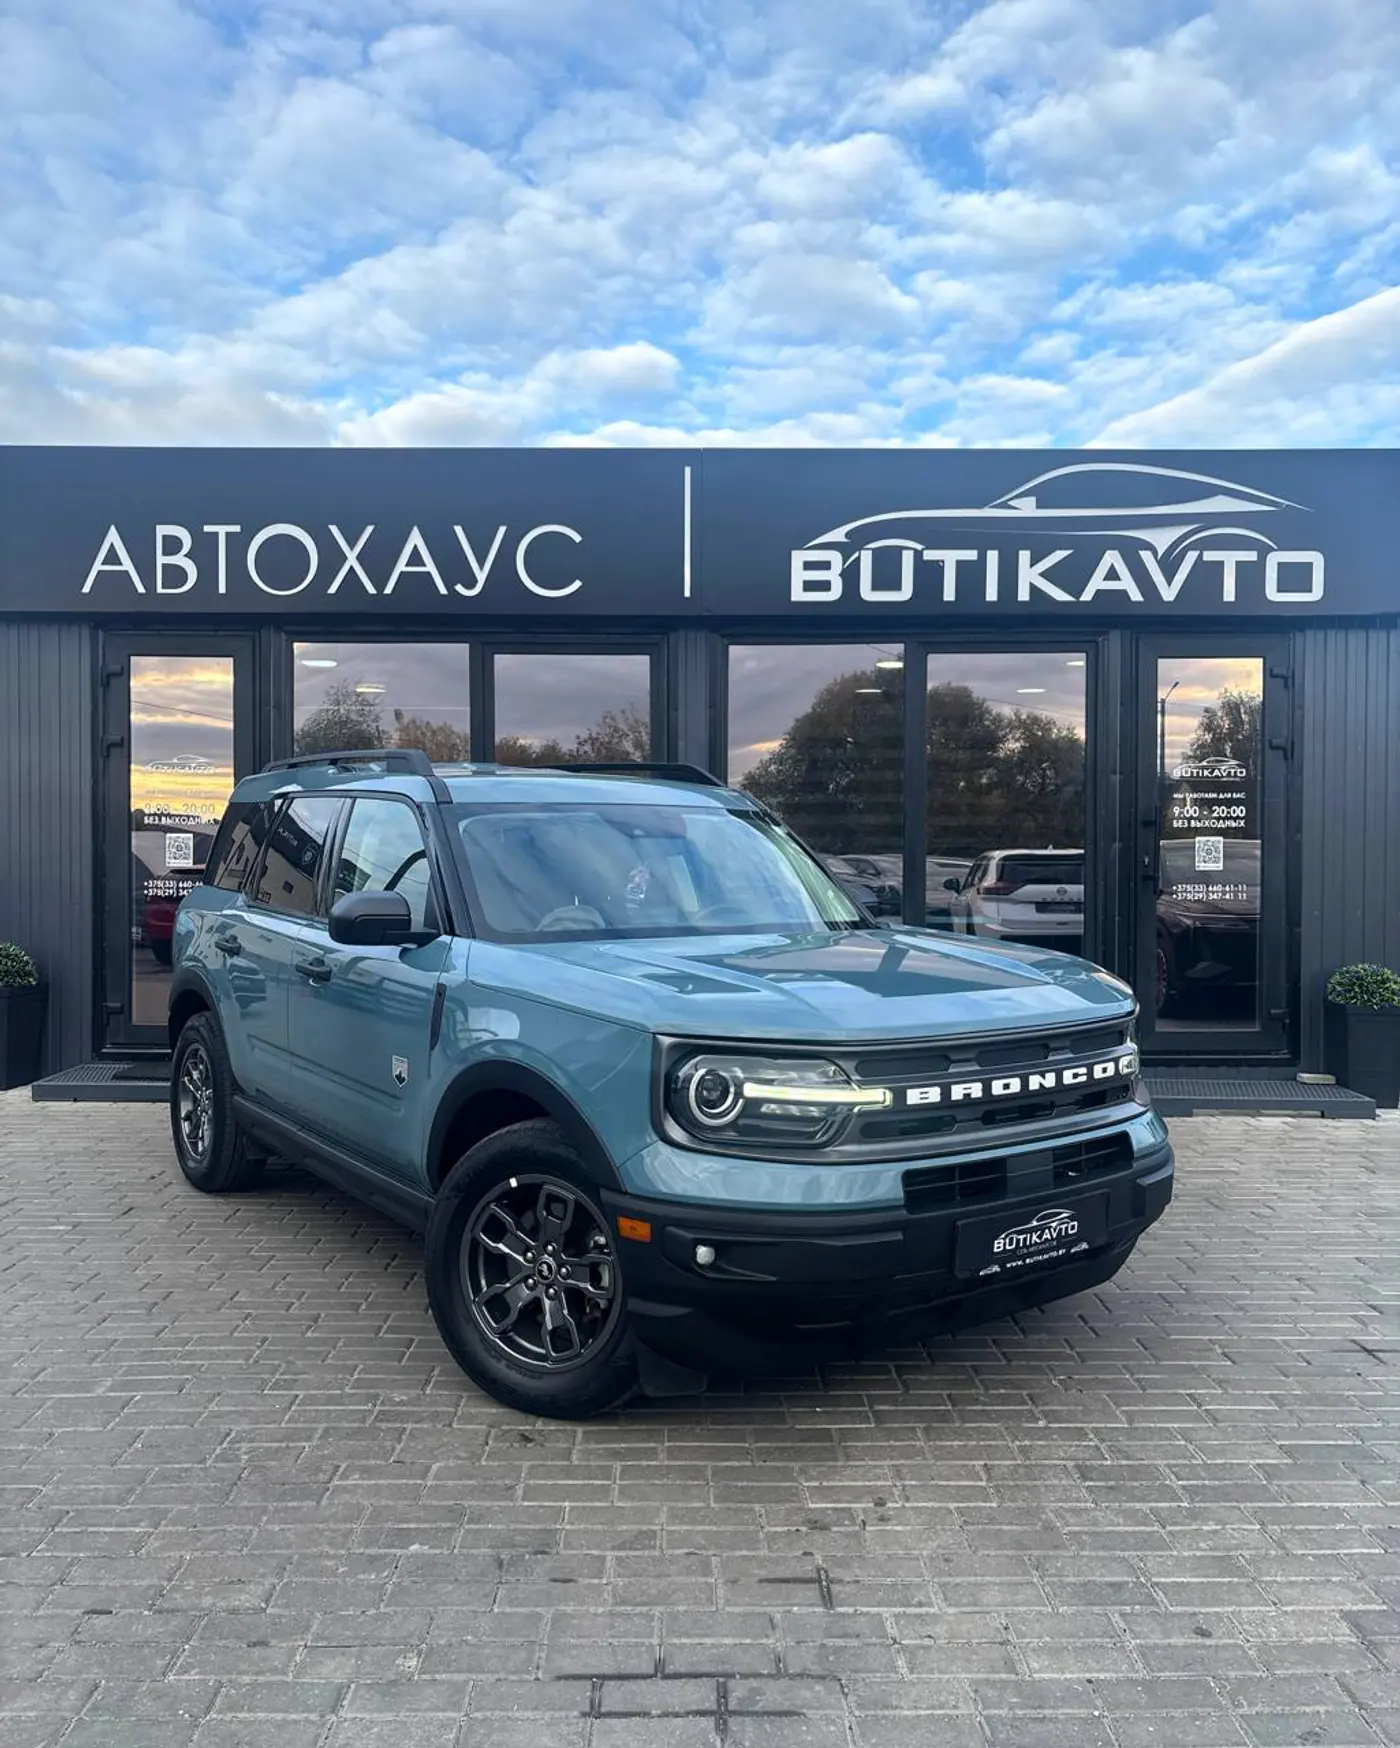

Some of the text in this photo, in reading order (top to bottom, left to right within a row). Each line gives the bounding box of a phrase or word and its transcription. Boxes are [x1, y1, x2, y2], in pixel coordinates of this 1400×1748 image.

[81, 523, 583, 598] АВТОХАУС
[790, 549, 1325, 602] BUTIKAVTO
[1173, 767, 1246, 777] BUTIKAVTO
[1172, 819, 1246, 829] БЕЗ ВЫХОДНЫХ
[1173, 806, 1200, 817] 9:00
[1211, 806, 1246, 817] 20:00
[906, 1061, 1115, 1105] BRONCO
[993, 1221, 1078, 1253] BUTIKAVTO
